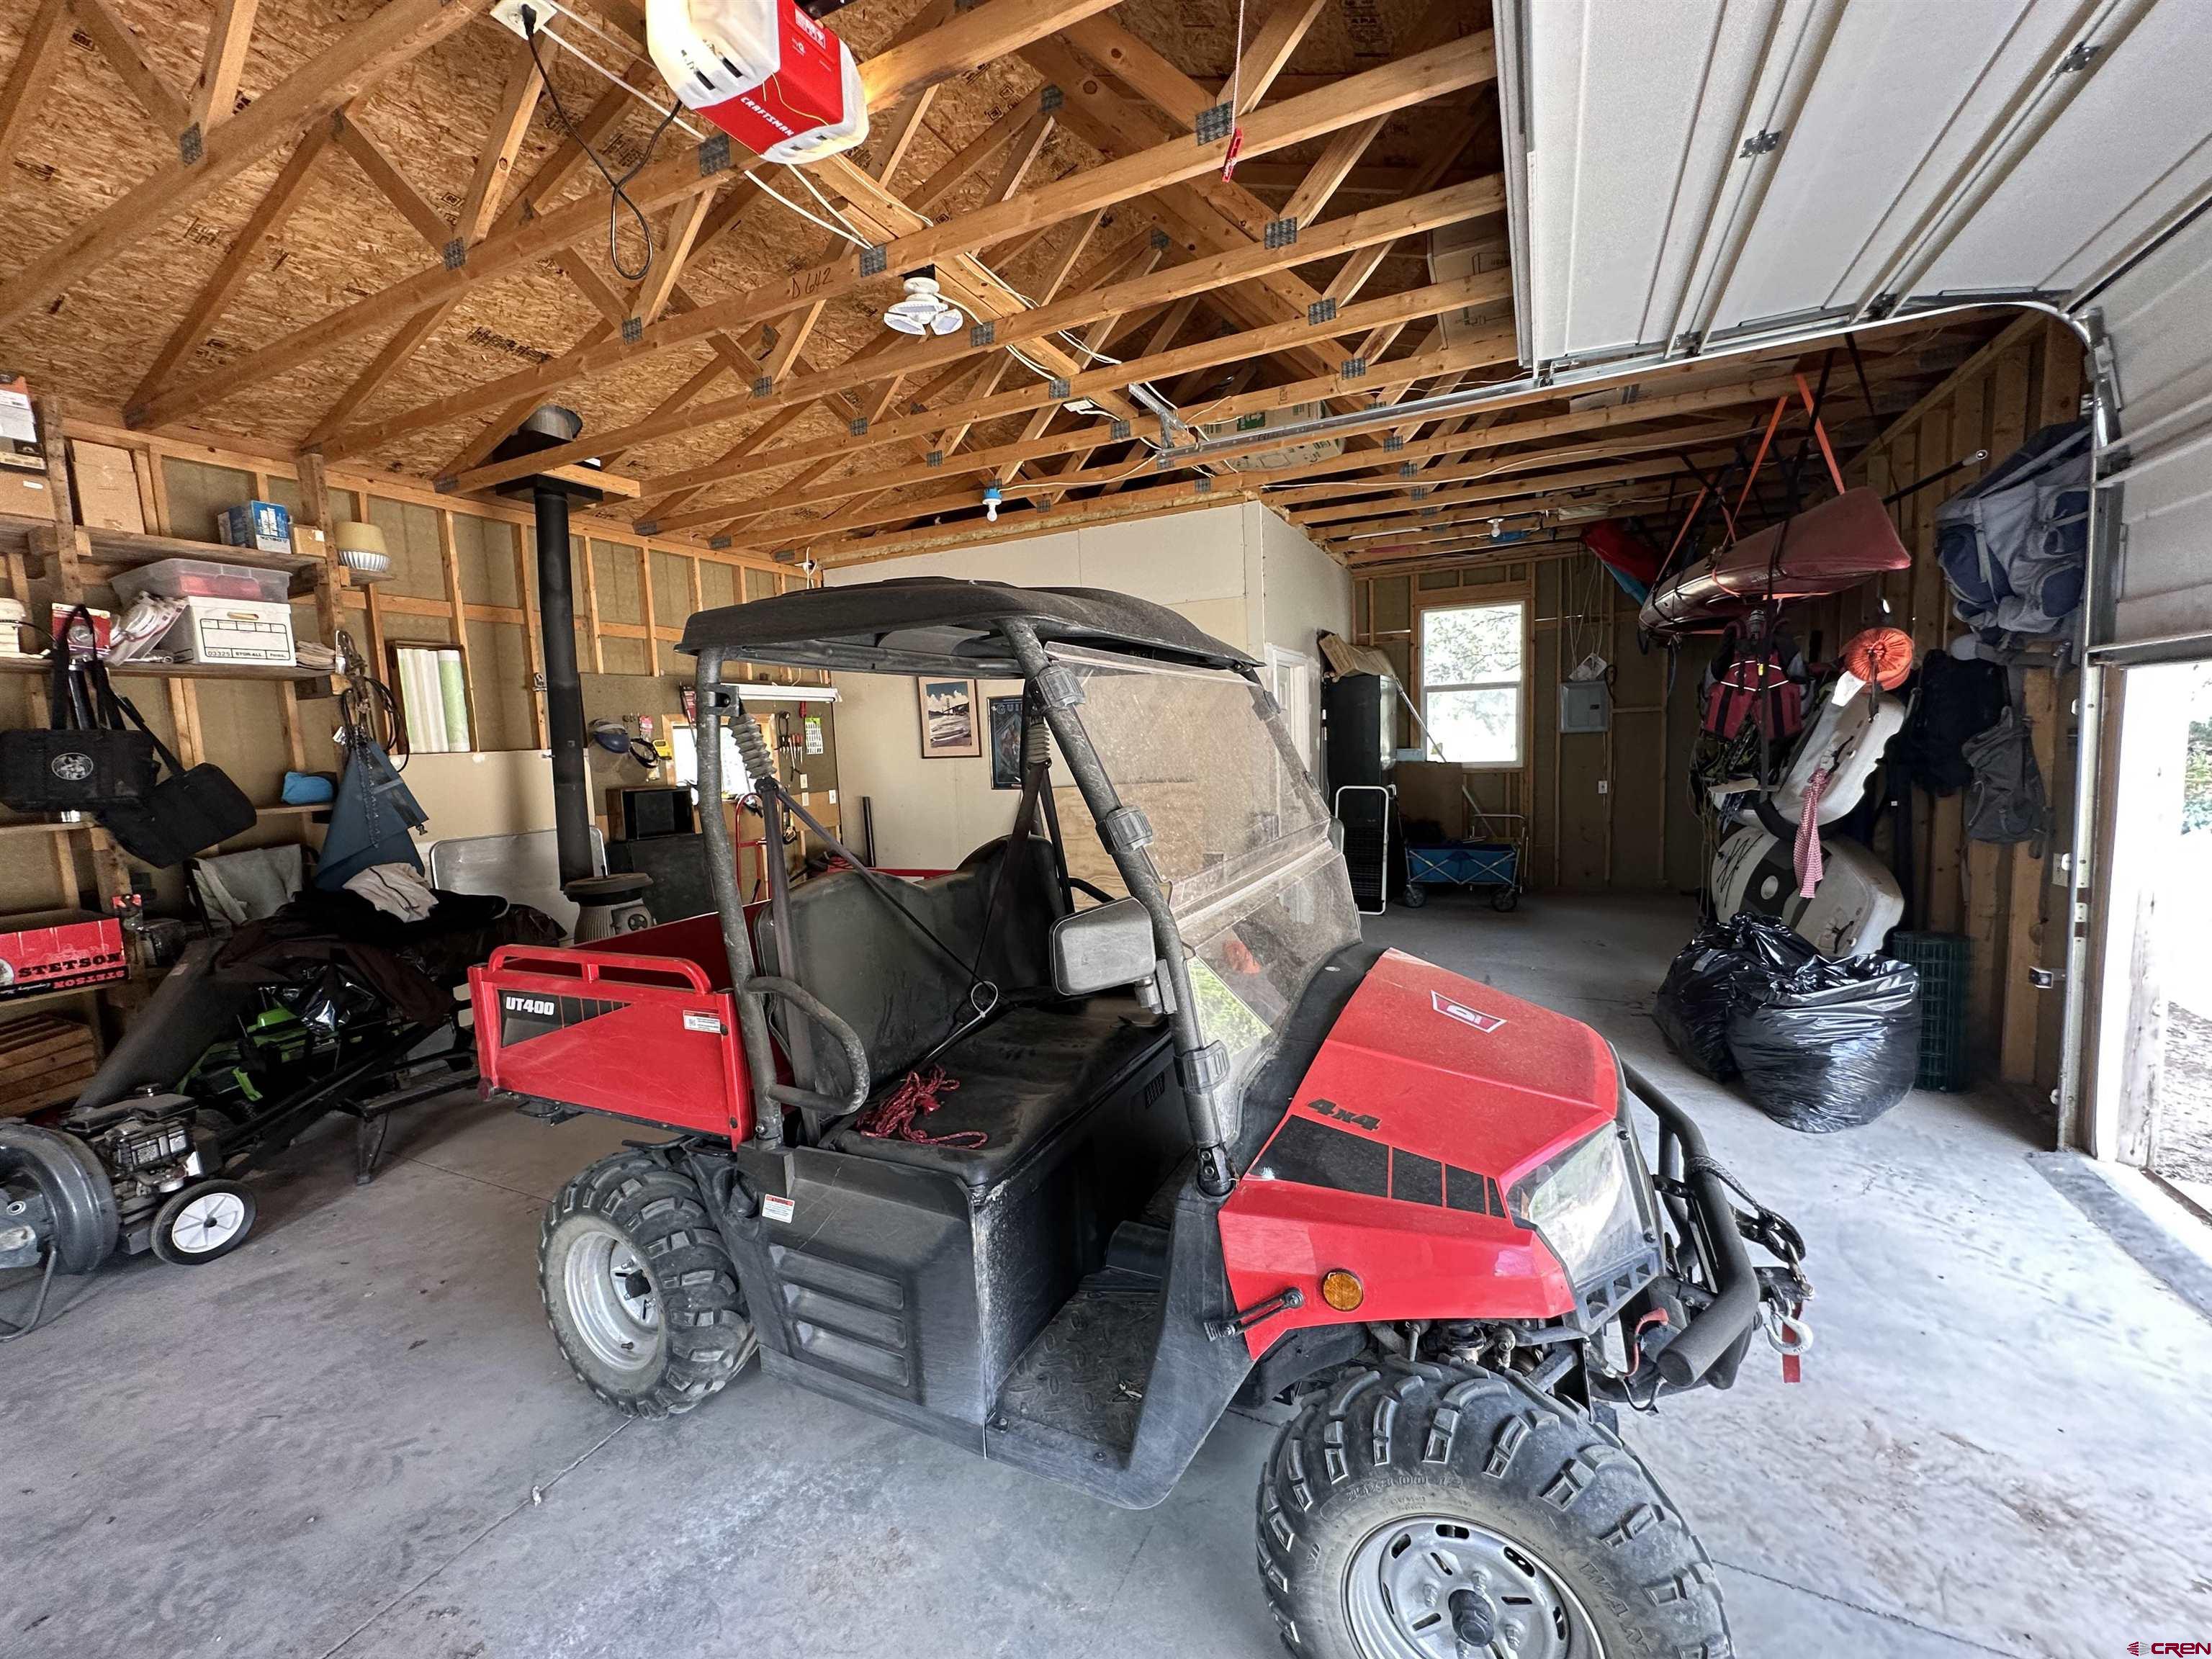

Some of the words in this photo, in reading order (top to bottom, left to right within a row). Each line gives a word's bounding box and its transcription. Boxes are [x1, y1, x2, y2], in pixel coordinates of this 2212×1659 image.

[740, 96, 795, 137] CRAFTSMAN
[792, 277, 801, 300] D
[805, 267, 835, 295] 642
[18, 952, 121, 978] STETSON
[53, 971, 125, 989] STETSON
[505, 996, 555, 1016] UT400
[1307, 1098, 1381, 1131] 4x4
